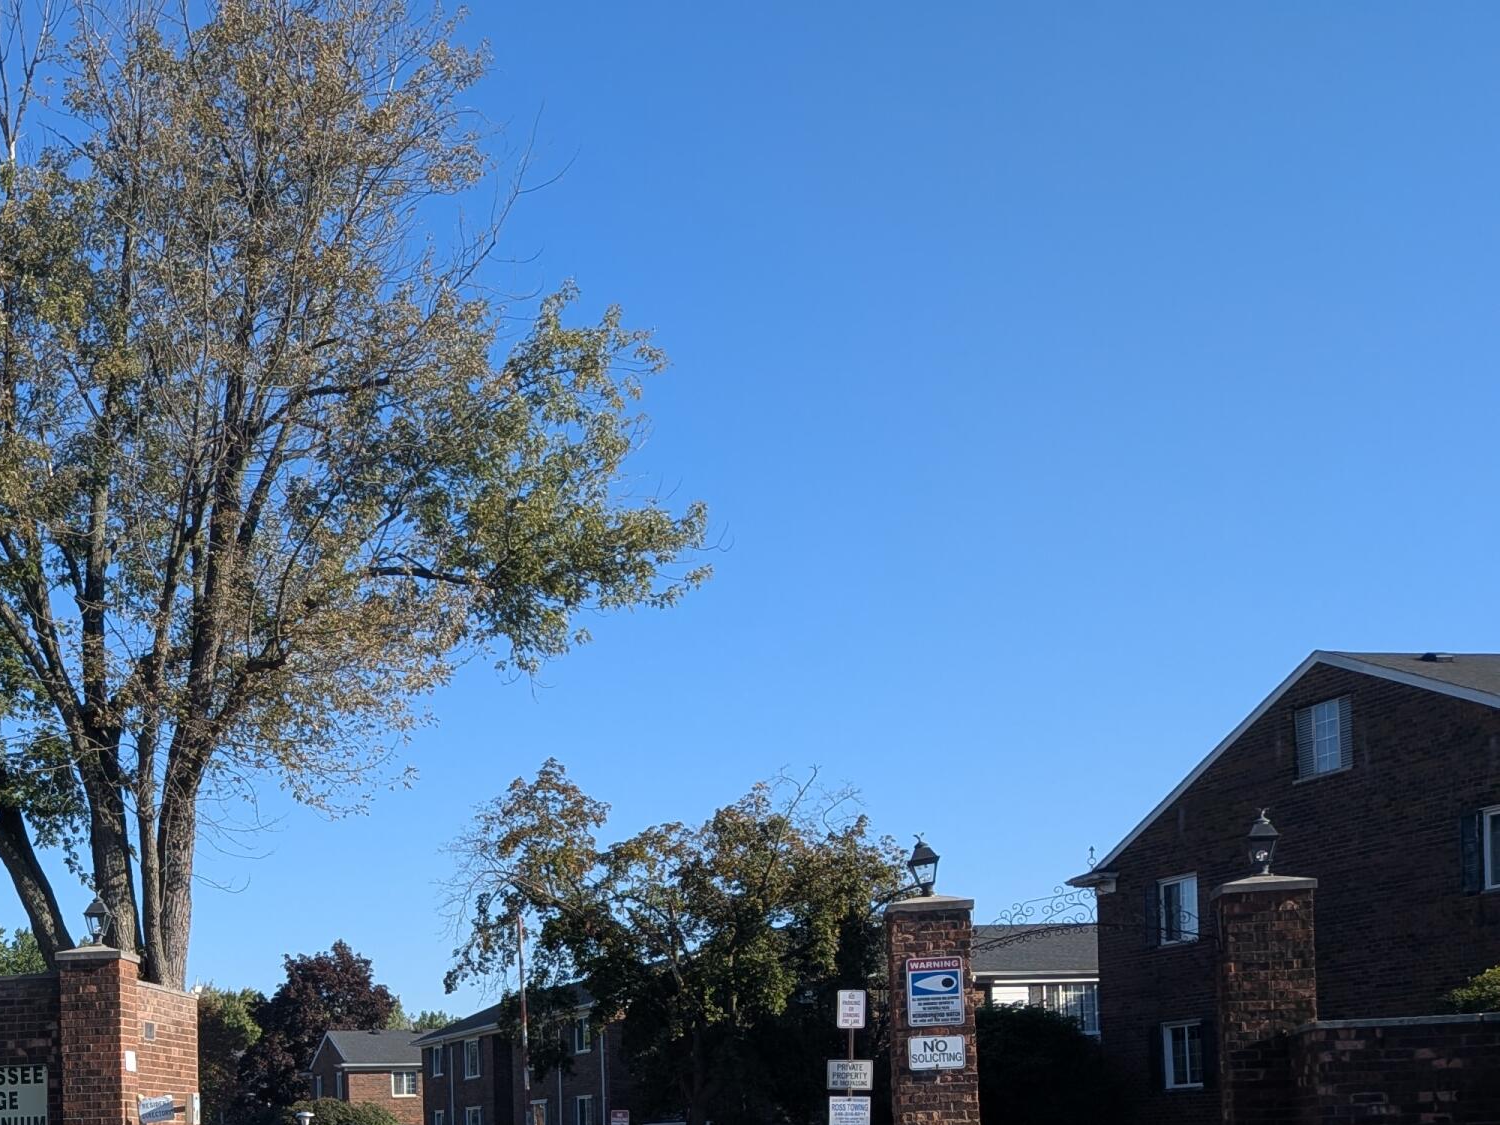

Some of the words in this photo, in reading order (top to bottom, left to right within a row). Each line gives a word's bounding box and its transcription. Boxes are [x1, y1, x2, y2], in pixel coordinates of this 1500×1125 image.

[910, 960, 959, 969] WARNING
[923, 1040, 948, 1053] NO
[911, 1052, 963, 1063] SOLICITING
[836, 1063, 864, 1071] PRIVATE
[832, 1071, 868, 1080] PROPERTY
